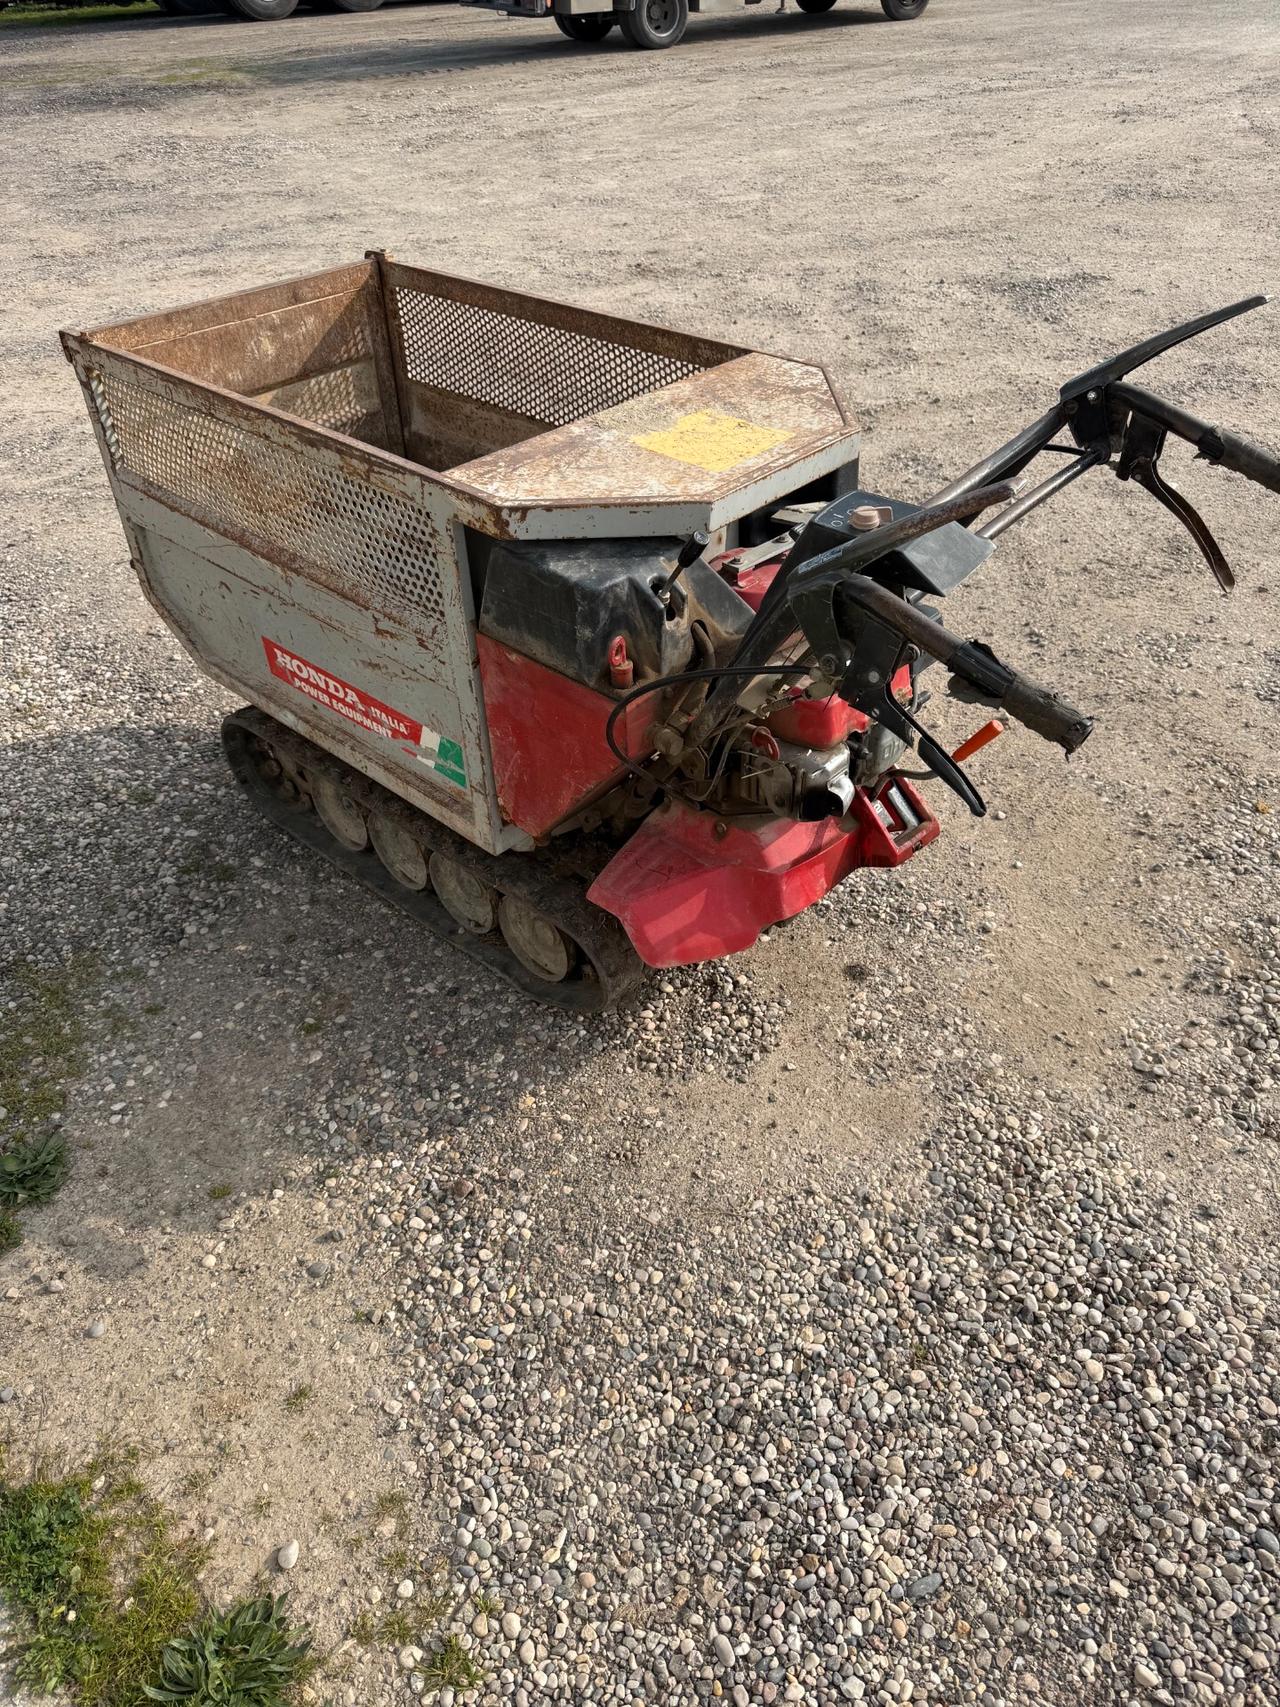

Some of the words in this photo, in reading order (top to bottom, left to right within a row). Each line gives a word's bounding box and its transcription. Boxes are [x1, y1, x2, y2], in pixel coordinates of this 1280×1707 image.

[273, 647, 366, 712] HONDA
[370, 706, 408, 735] ITALIA
[294, 678, 331, 706] POWER
[332, 700, 393, 739] EQUIPMENT
